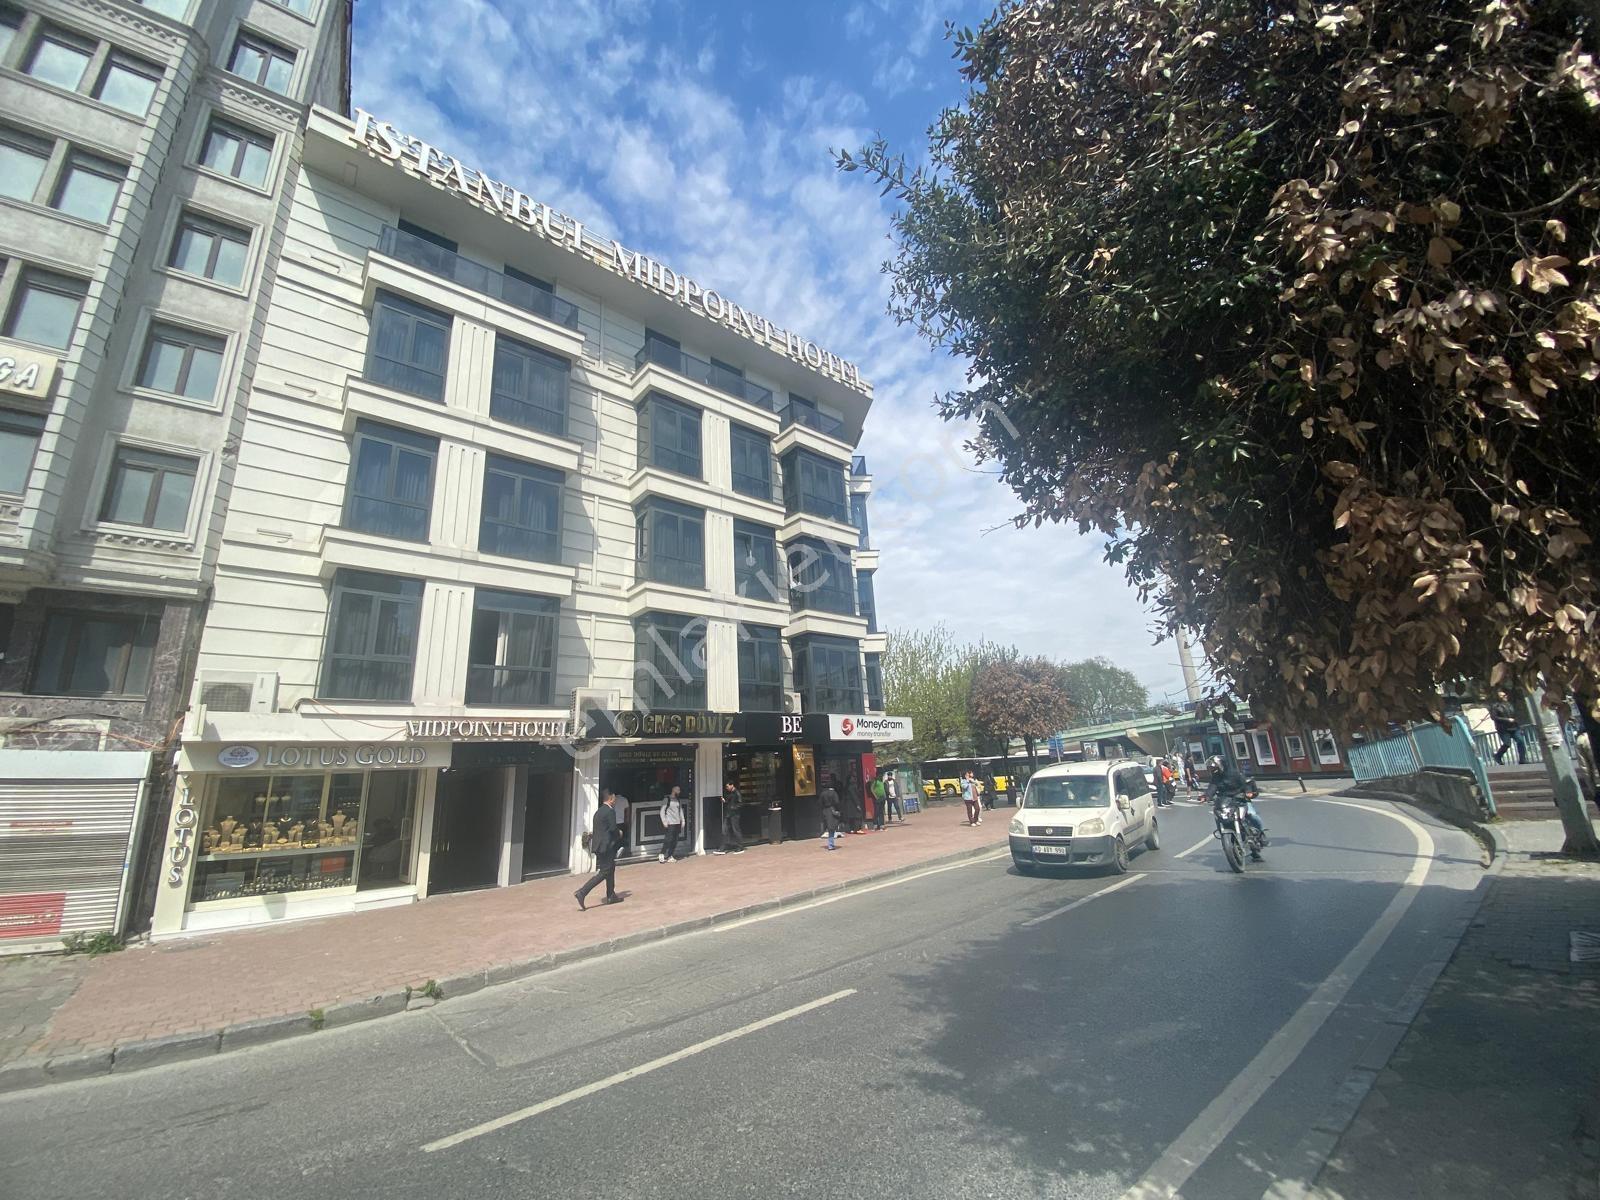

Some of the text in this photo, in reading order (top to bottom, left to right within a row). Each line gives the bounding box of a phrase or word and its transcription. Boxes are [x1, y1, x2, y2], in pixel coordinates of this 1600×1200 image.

[349, 107, 867, 392] ISTANBUL MIDPOINT HOTEL
[264, 744, 427, 767] LOTUS GOLD
[407, 719, 568, 738] MIDPOINT HOTEL
[169, 788, 195, 883] LOTUS
